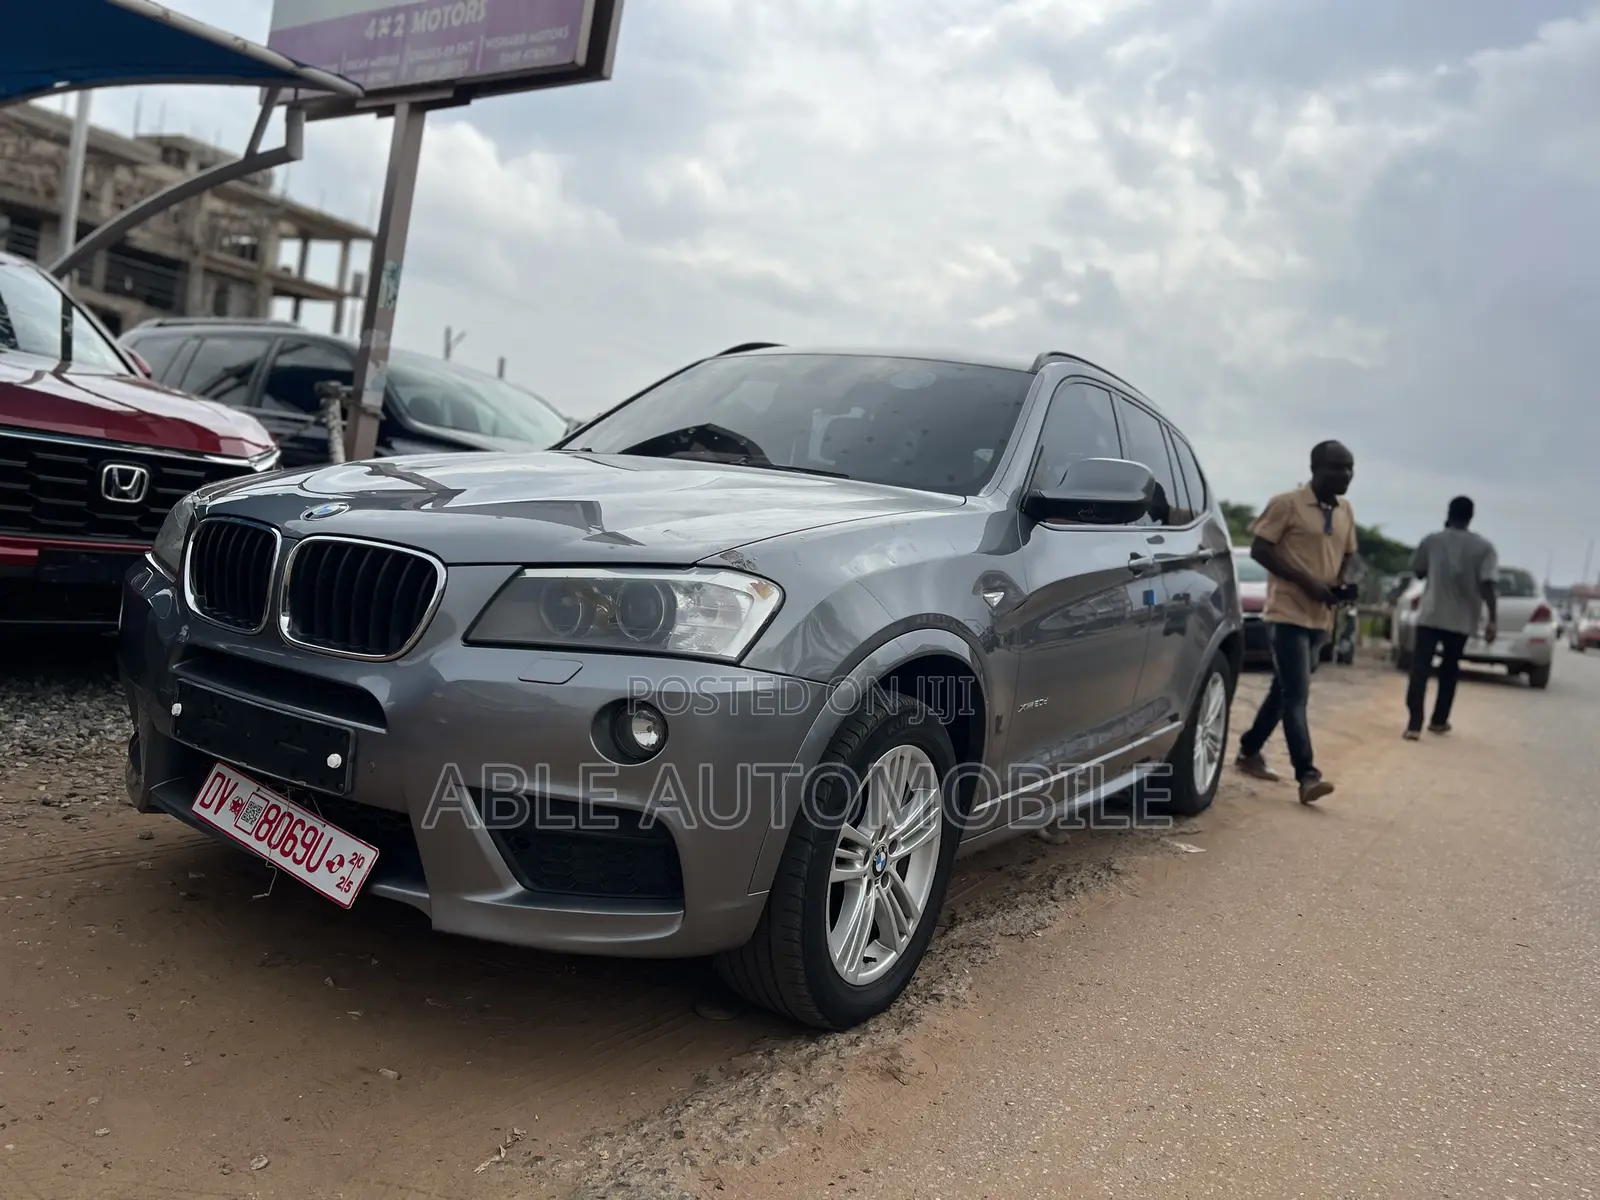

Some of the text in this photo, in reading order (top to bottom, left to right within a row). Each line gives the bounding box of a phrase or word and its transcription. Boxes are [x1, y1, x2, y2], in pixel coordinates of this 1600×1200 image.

[411, 0, 485, 33] MOTORS
[199, 771, 333, 873] DV 8069U
[348, 852, 365, 869] 20
[335, 876, 354, 893] 25
